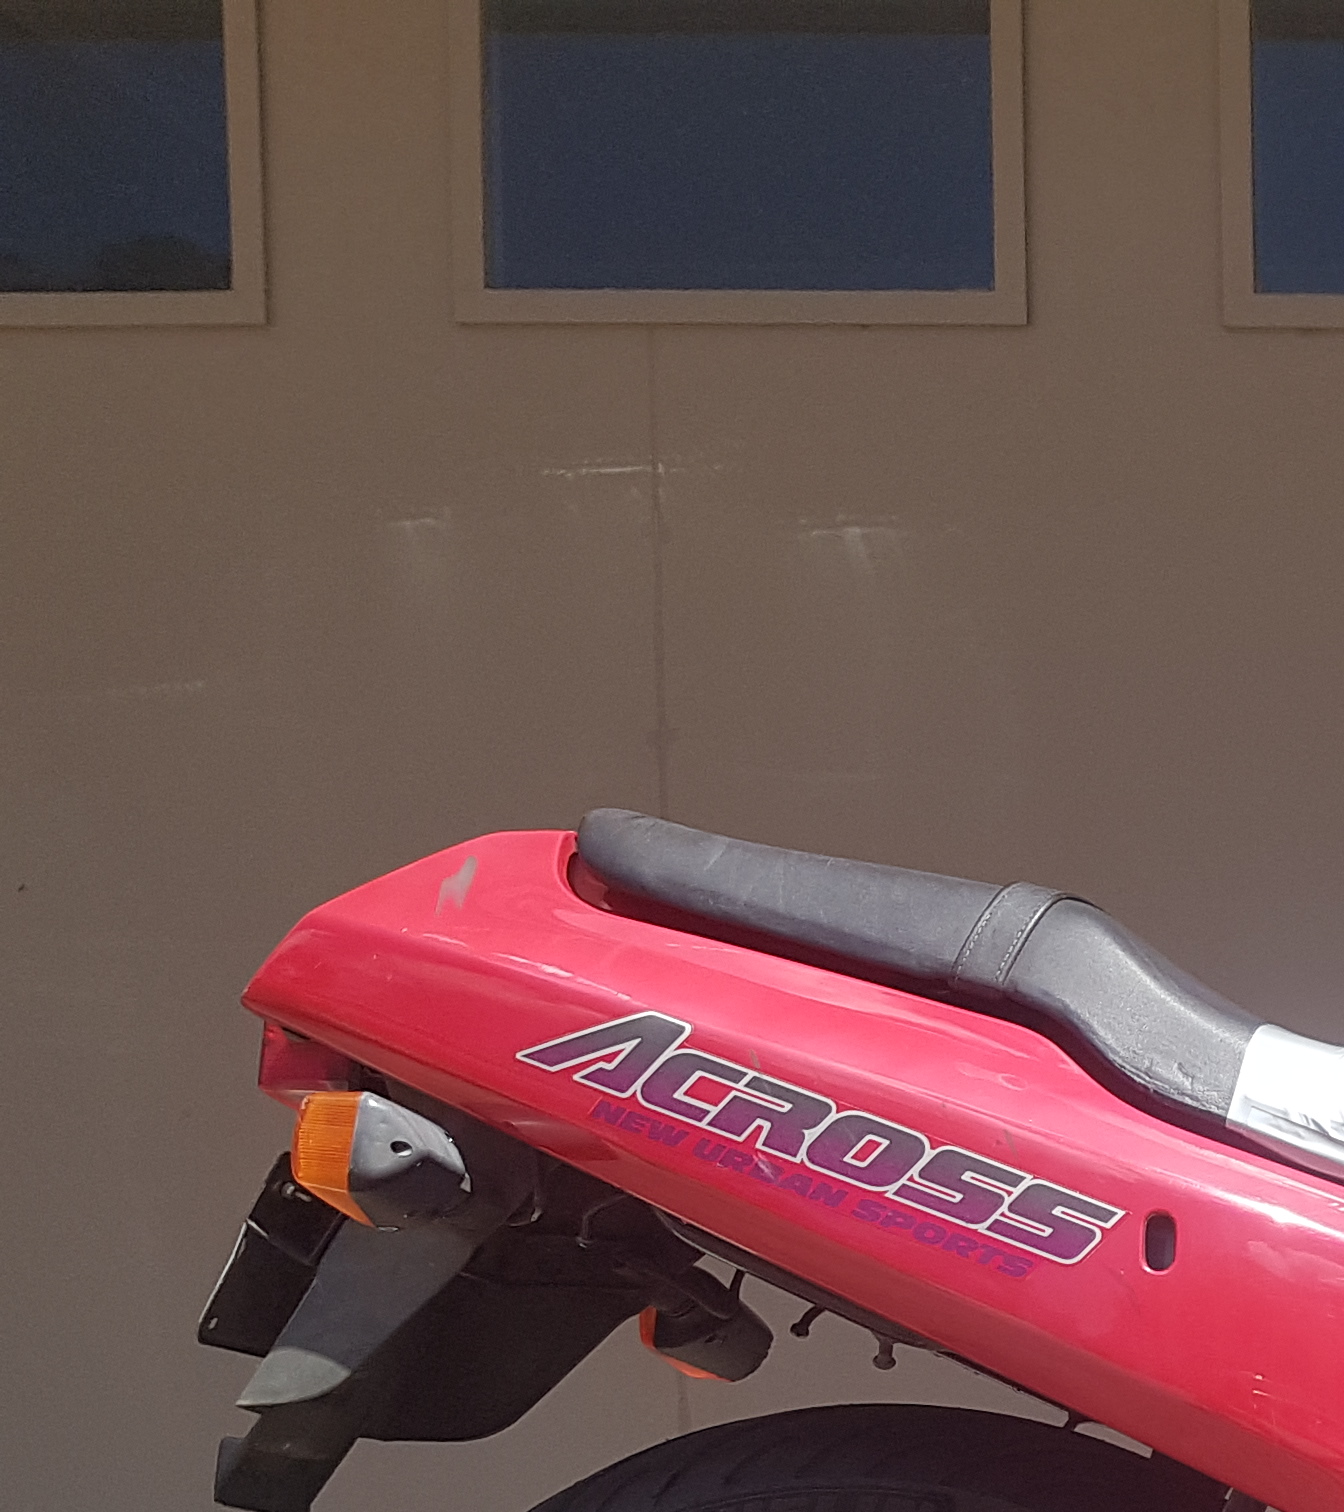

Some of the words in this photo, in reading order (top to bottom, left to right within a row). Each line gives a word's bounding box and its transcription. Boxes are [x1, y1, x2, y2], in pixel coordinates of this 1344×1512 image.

[515, 1010, 1129, 1265] ACROSS
[592, 1099, 684, 1149] NEW
[691, 1137, 846, 1210] URBAN
[851, 1197, 1038, 1278] SPORTS
